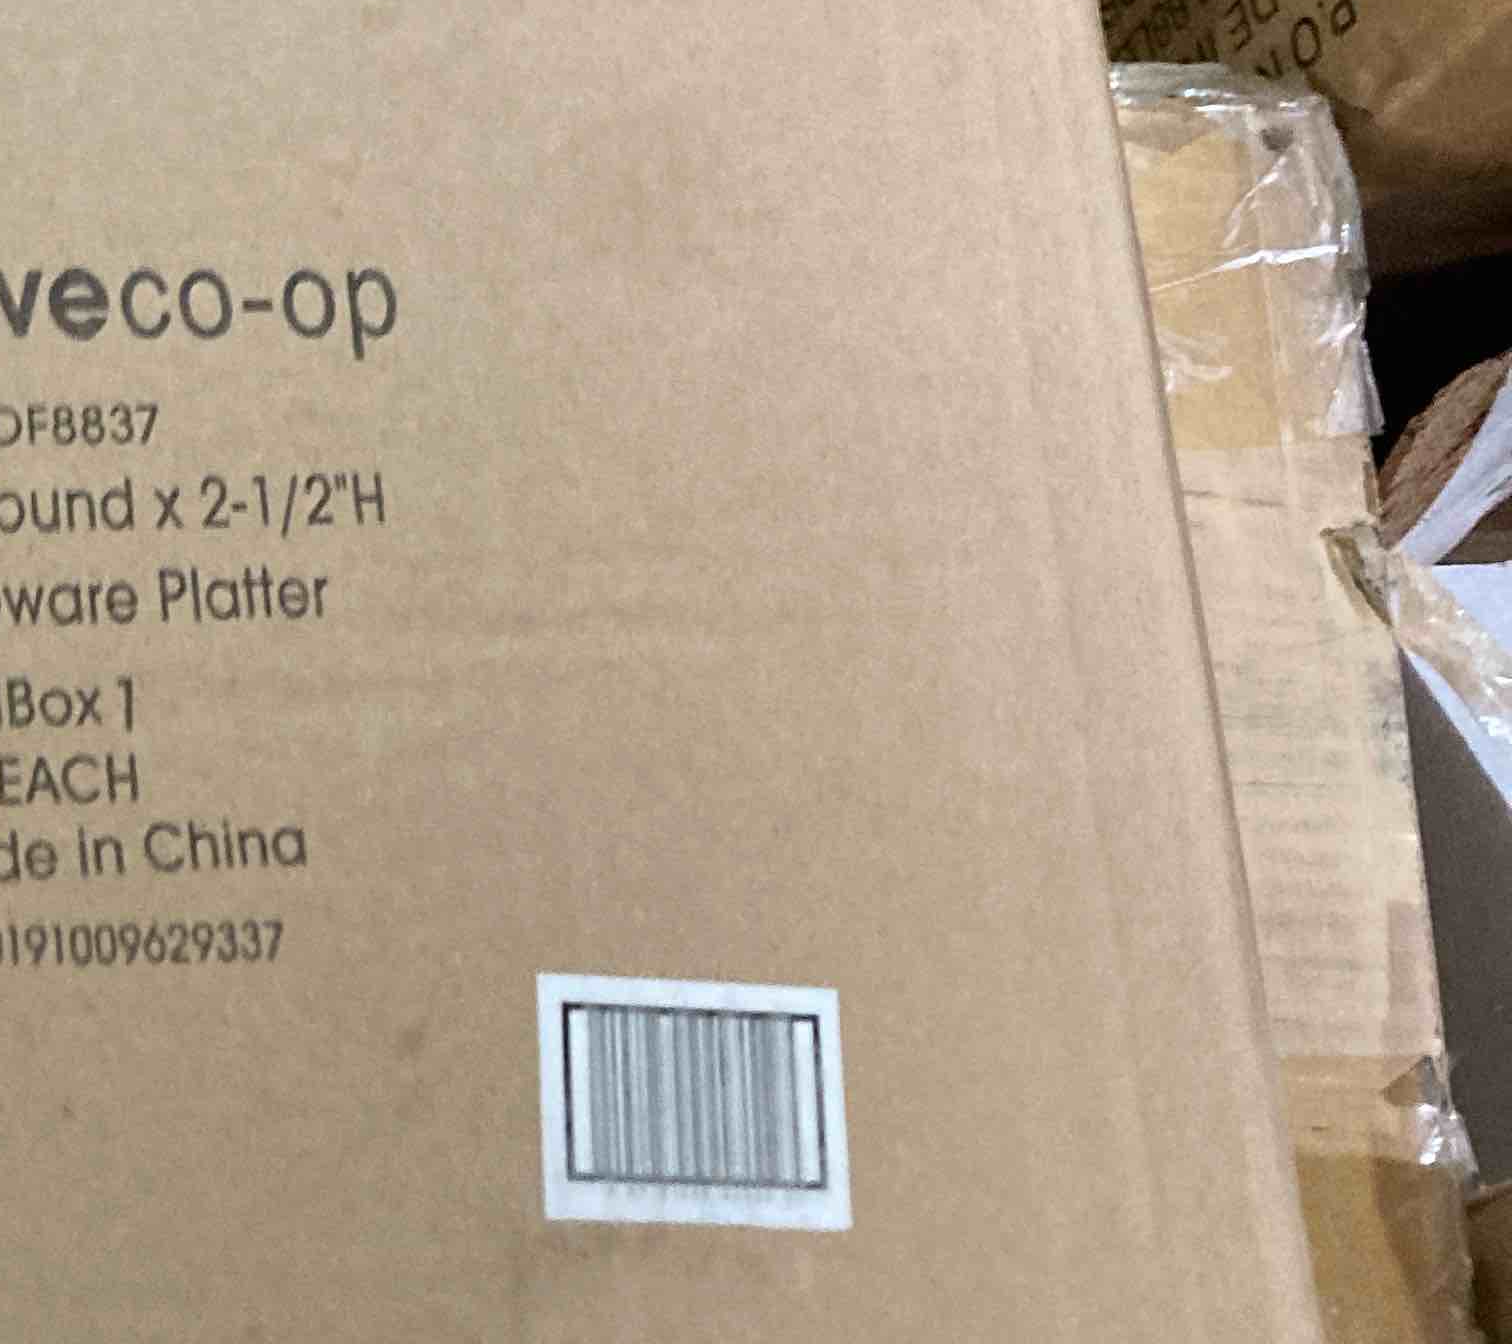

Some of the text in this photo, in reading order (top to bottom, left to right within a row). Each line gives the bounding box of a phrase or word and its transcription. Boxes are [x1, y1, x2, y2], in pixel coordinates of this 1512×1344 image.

[154, 483, 186, 531] x
[199, 471, 387, 539] 2-1/2"H
[158, 566, 328, 624] Platter
[117, 673, 136, 733] 1
[144, 818, 308, 873] China
